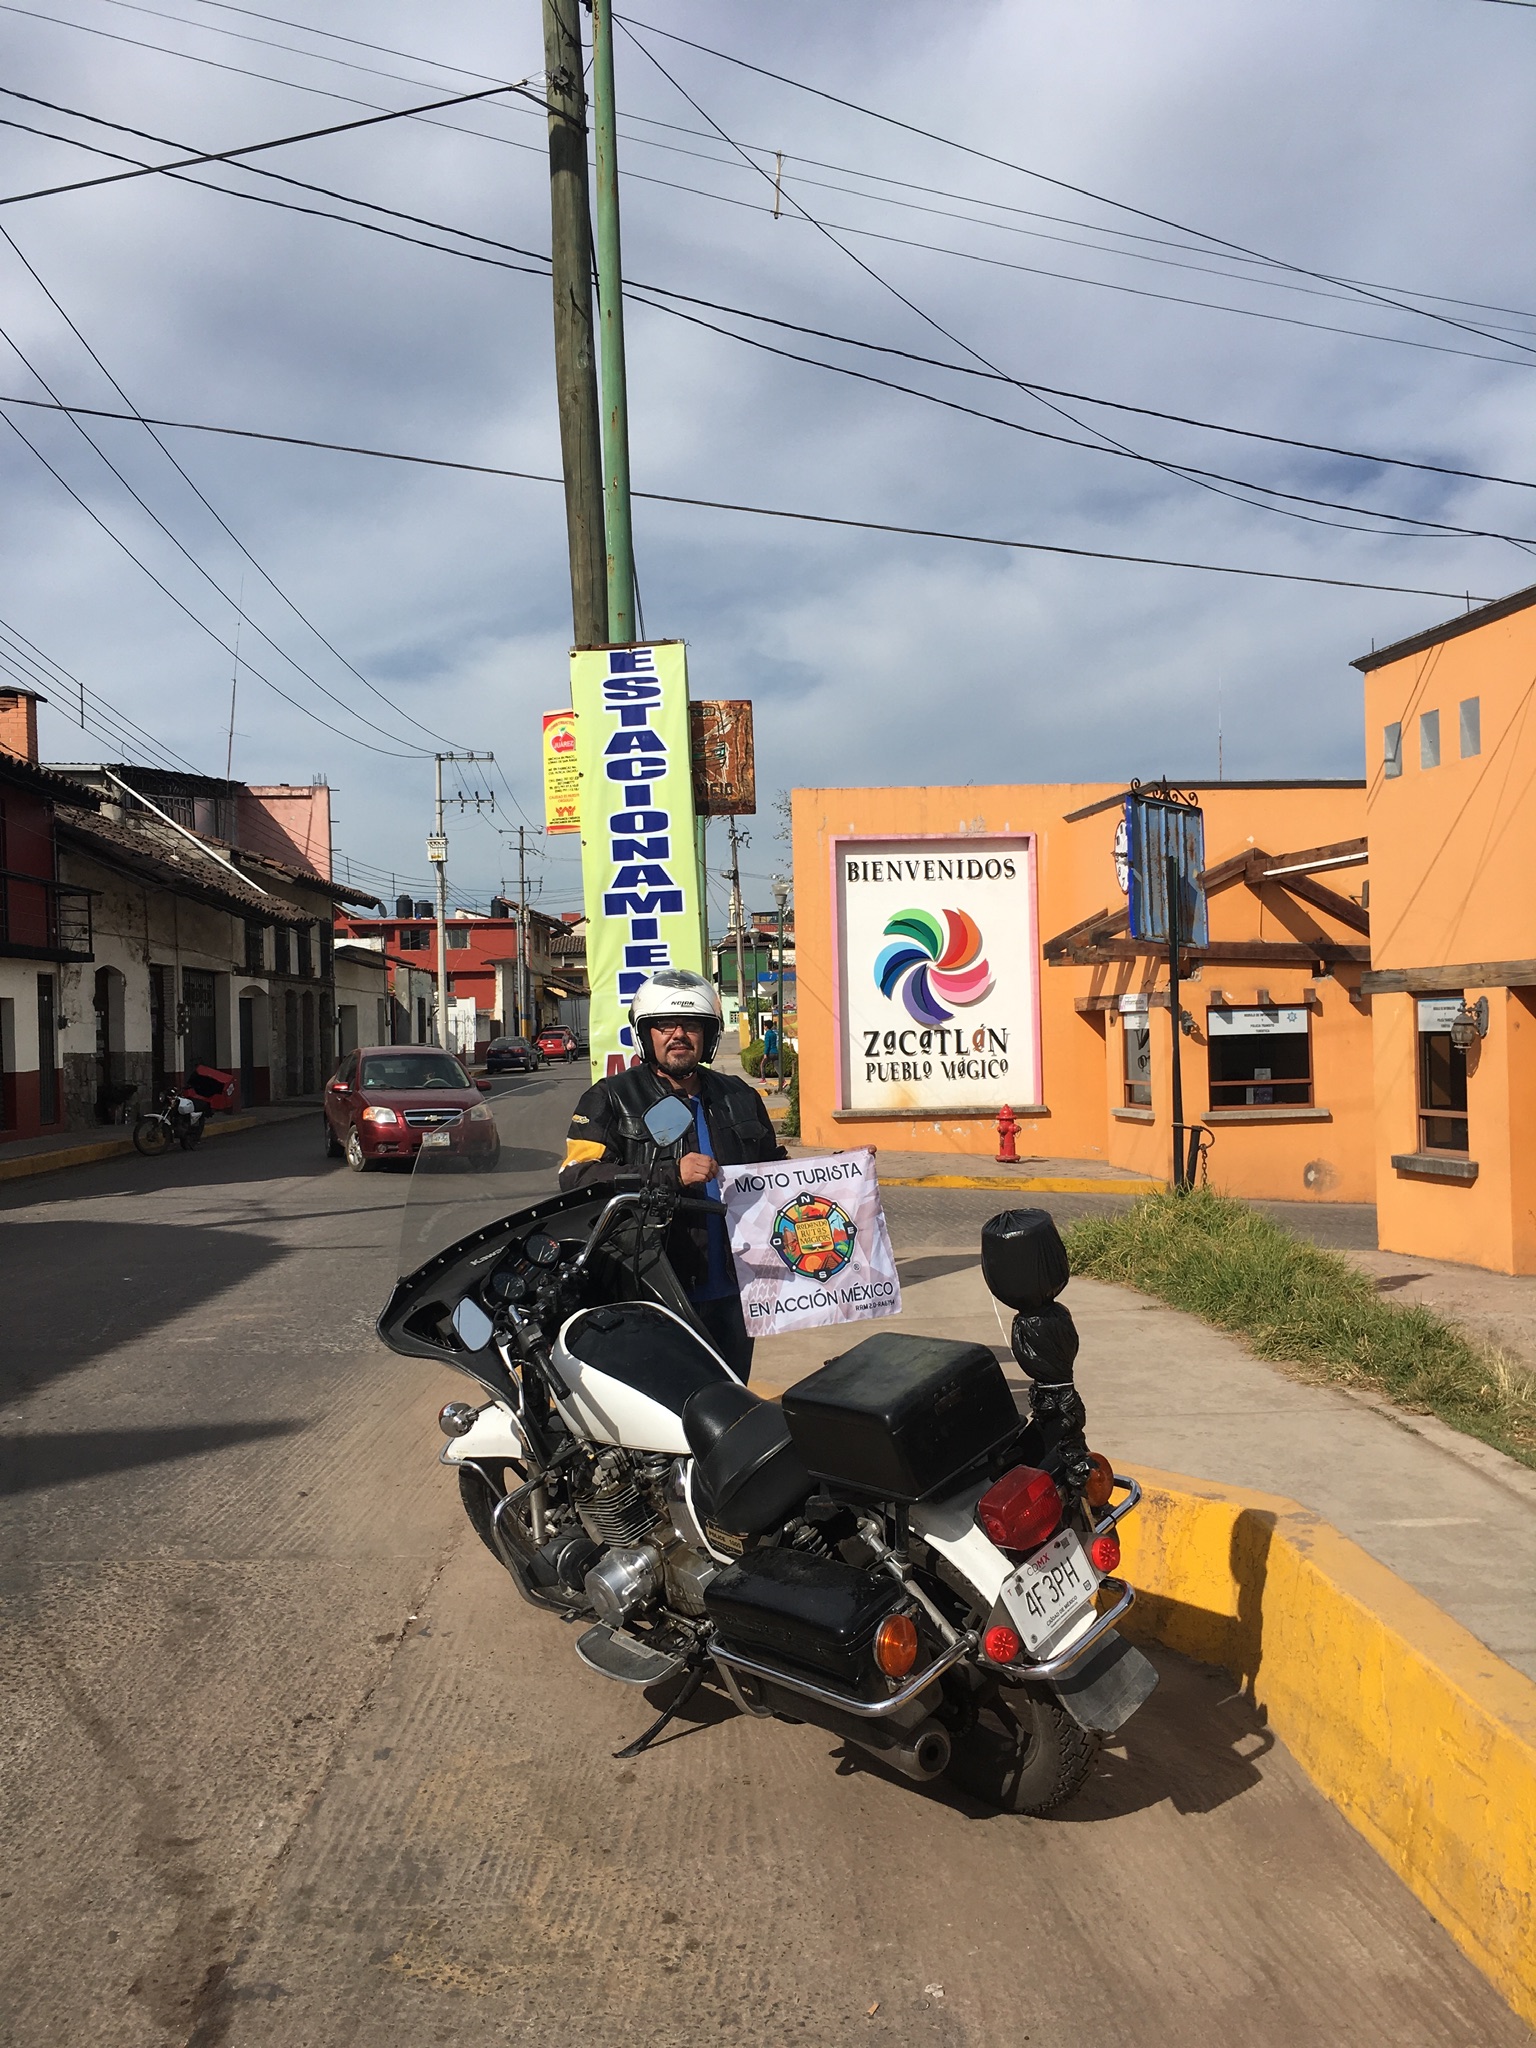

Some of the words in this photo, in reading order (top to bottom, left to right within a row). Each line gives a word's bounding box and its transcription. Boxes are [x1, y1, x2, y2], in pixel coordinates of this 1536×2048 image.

[604, 649, 684, 1047] ESTACIONAMIEN
[847, 858, 1016, 882] BIENVENIDOS
[734, 1173, 790, 1193] MOTO
[793, 1162, 863, 1186] TURISTA
[801, 1195, 810, 1204] N
[818, 1270, 827, 1279] S
[749, 1302, 770, 1318] EN
[774, 1288, 838, 1315] ACCIÓN
[841, 1281, 894, 1304] MÉXICO
[1026, 1552, 1050, 1577] CDMX
